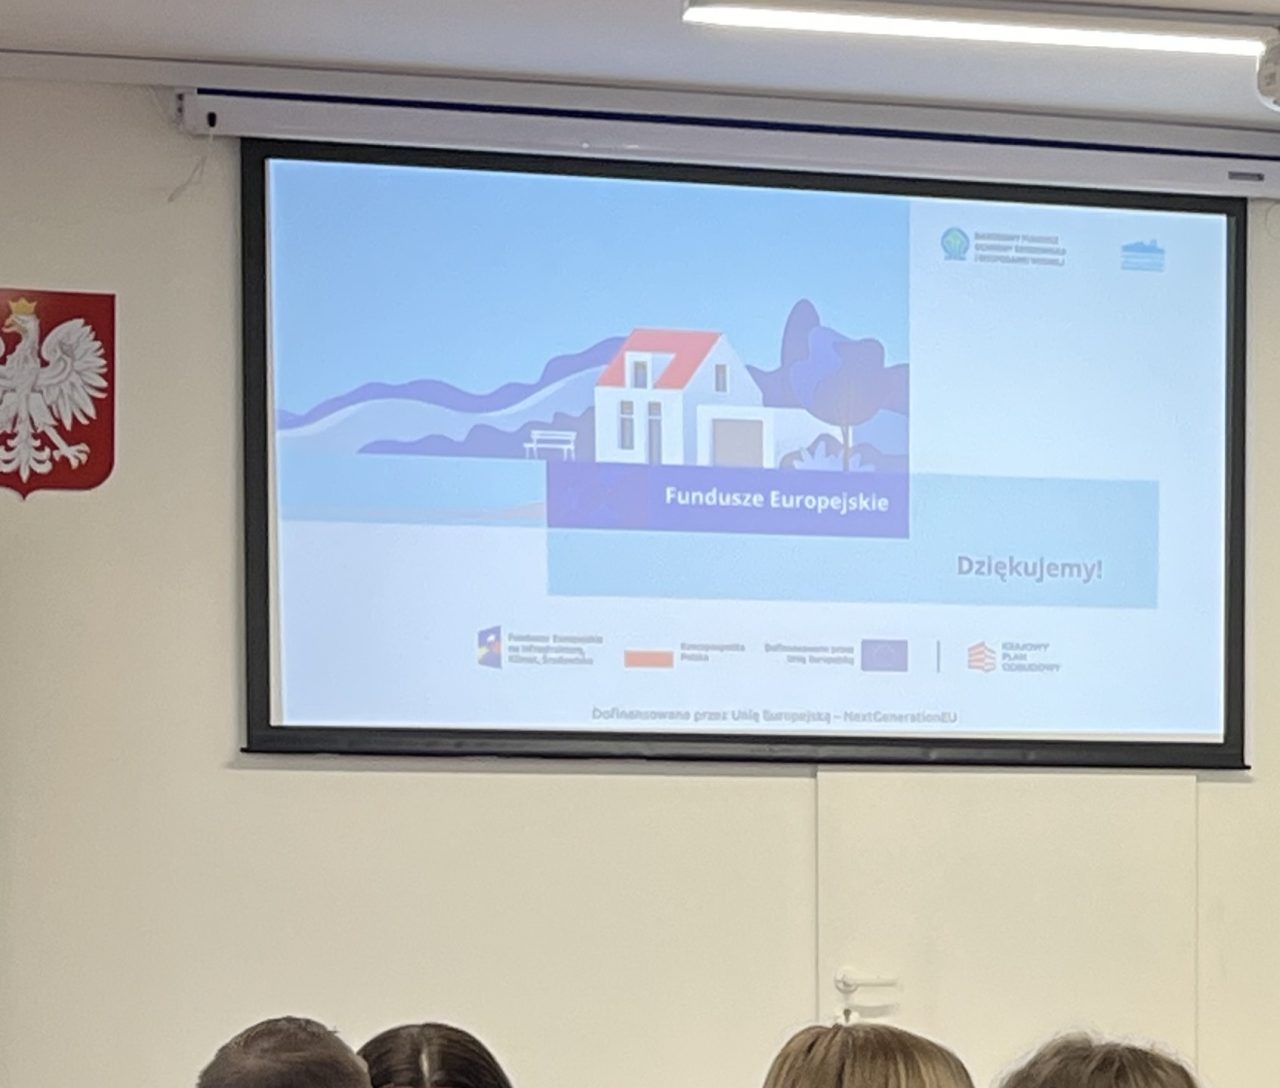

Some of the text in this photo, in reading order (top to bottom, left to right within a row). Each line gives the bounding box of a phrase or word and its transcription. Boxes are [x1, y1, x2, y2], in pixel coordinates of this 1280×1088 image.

[665, 486, 889, 516] Fundusze Europejskie
[957, 554, 1103, 583] Dziękujemy!
[842, 709, 958, 724] NextGenerationEU
